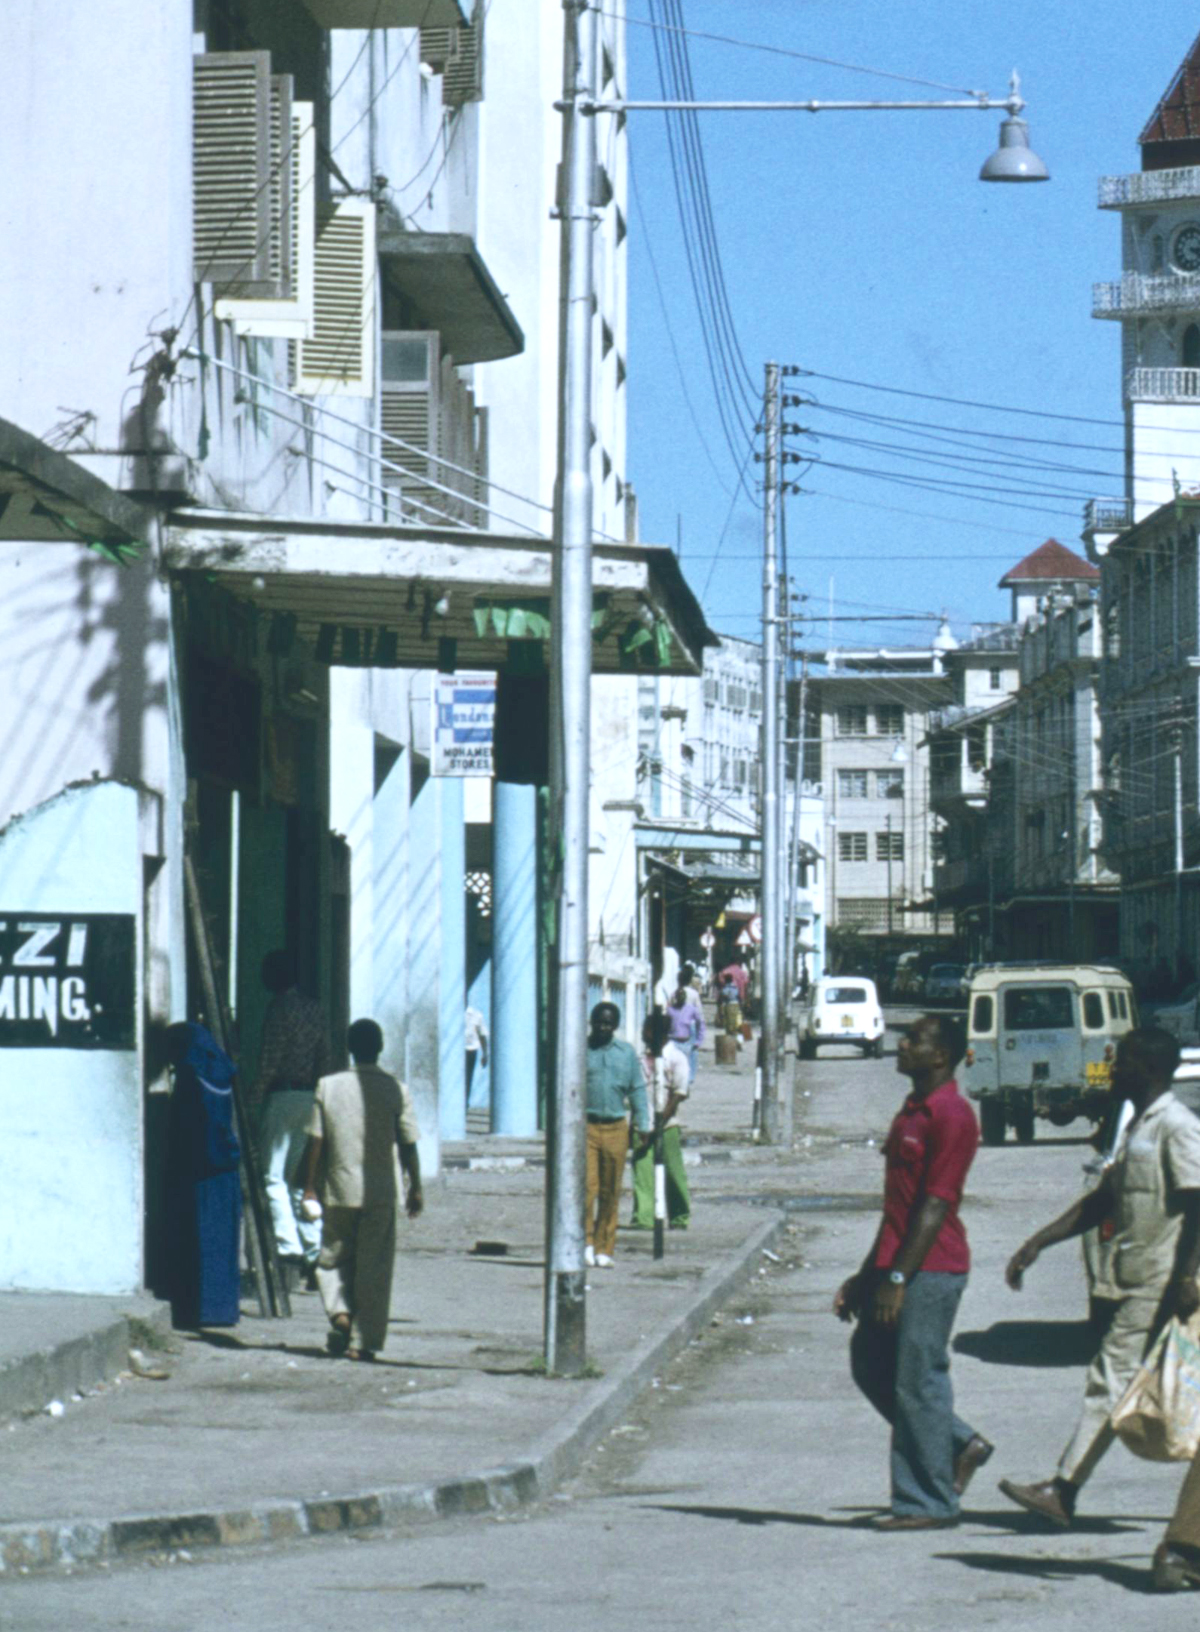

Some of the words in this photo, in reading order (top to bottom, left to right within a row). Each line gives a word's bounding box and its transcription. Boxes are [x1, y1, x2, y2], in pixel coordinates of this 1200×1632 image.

[443, 747, 495, 758] MOHAME
[450, 758, 490, 770] STORES
[0, 922, 88, 967] ZI
